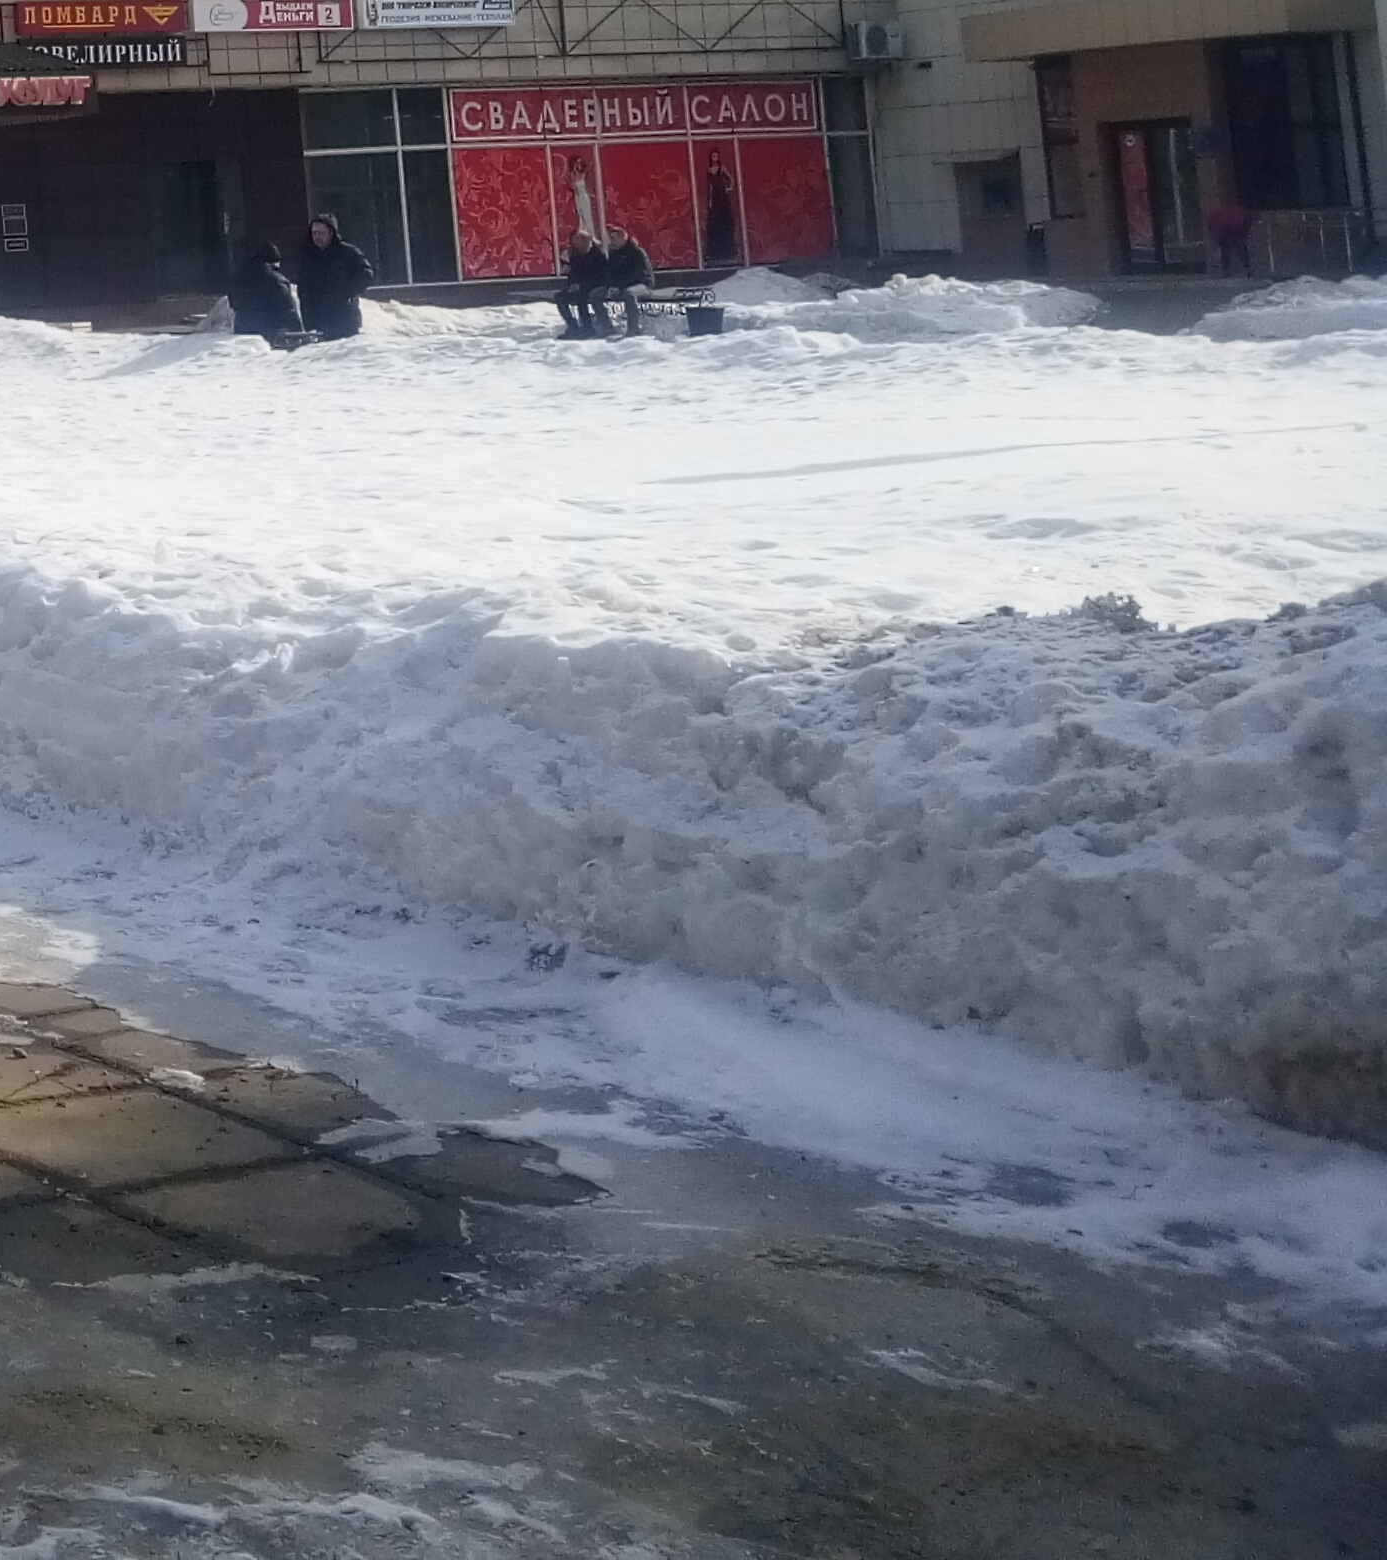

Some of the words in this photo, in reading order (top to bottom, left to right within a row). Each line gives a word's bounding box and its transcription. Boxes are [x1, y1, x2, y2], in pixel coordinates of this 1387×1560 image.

[26, 38, 182, 65] ВЕЛИРНЫЙ
[460, 88, 674, 134] СВАДЕБНЫЙ
[690, 92, 809, 124] САЛОН
